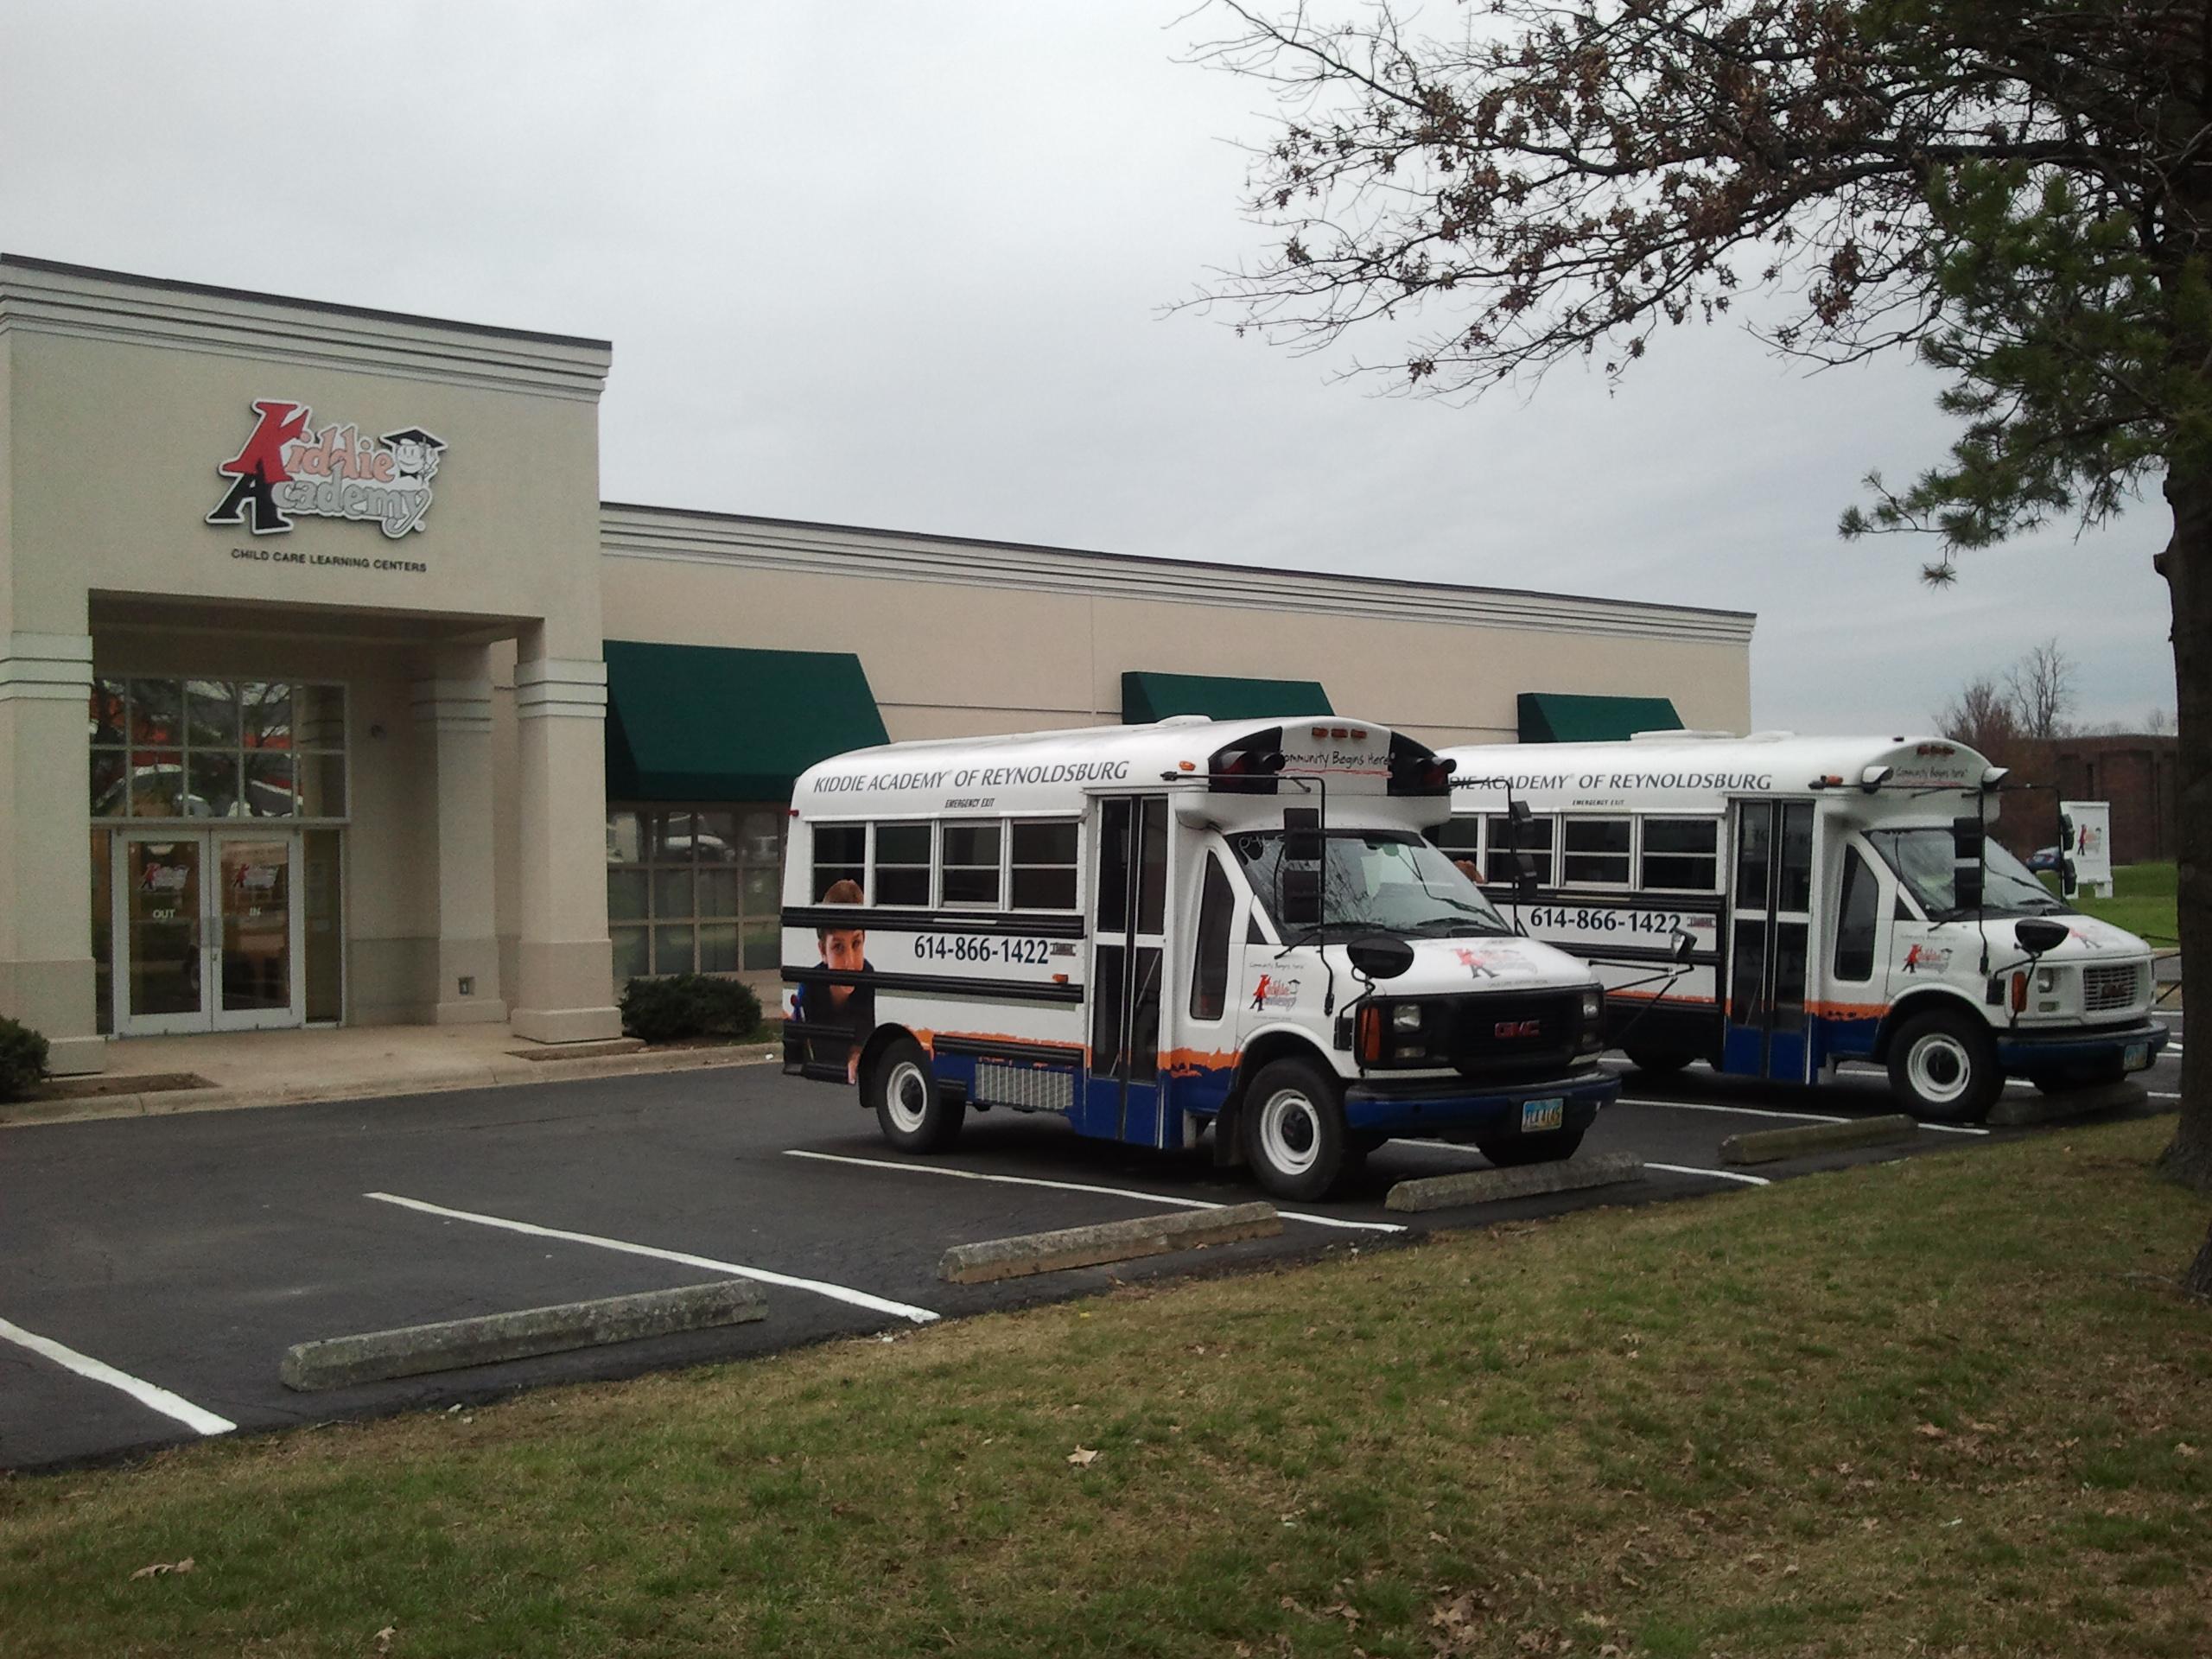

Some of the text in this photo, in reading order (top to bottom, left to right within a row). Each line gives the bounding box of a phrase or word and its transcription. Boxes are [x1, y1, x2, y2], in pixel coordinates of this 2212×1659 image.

[220, 400, 396, 483] Kiddie
[207, 462, 430, 534] Academy
[231, 548, 427, 572] CHILD CARE LEARNING CENTERS
[1283, 753, 1329, 768] ommunity
[1332, 751, 1364, 769] Begins
[813, 760, 1129, 793] KIDDIE ACADEMY OF REYNOLDSBURG
[1579, 773, 1606, 790] OF
[1609, 773, 1772, 791] REYNOLDSBURG
[944, 798, 995, 809] EMERGENCY EXIT
[152, 909, 176, 918] OUT
[249, 907, 262, 917] IN
[1530, 907, 1681, 934] 614-866-1422
[913, 935, 1049, 964] 614-866-1422
[1494, 1020, 1540, 1038] GMC
